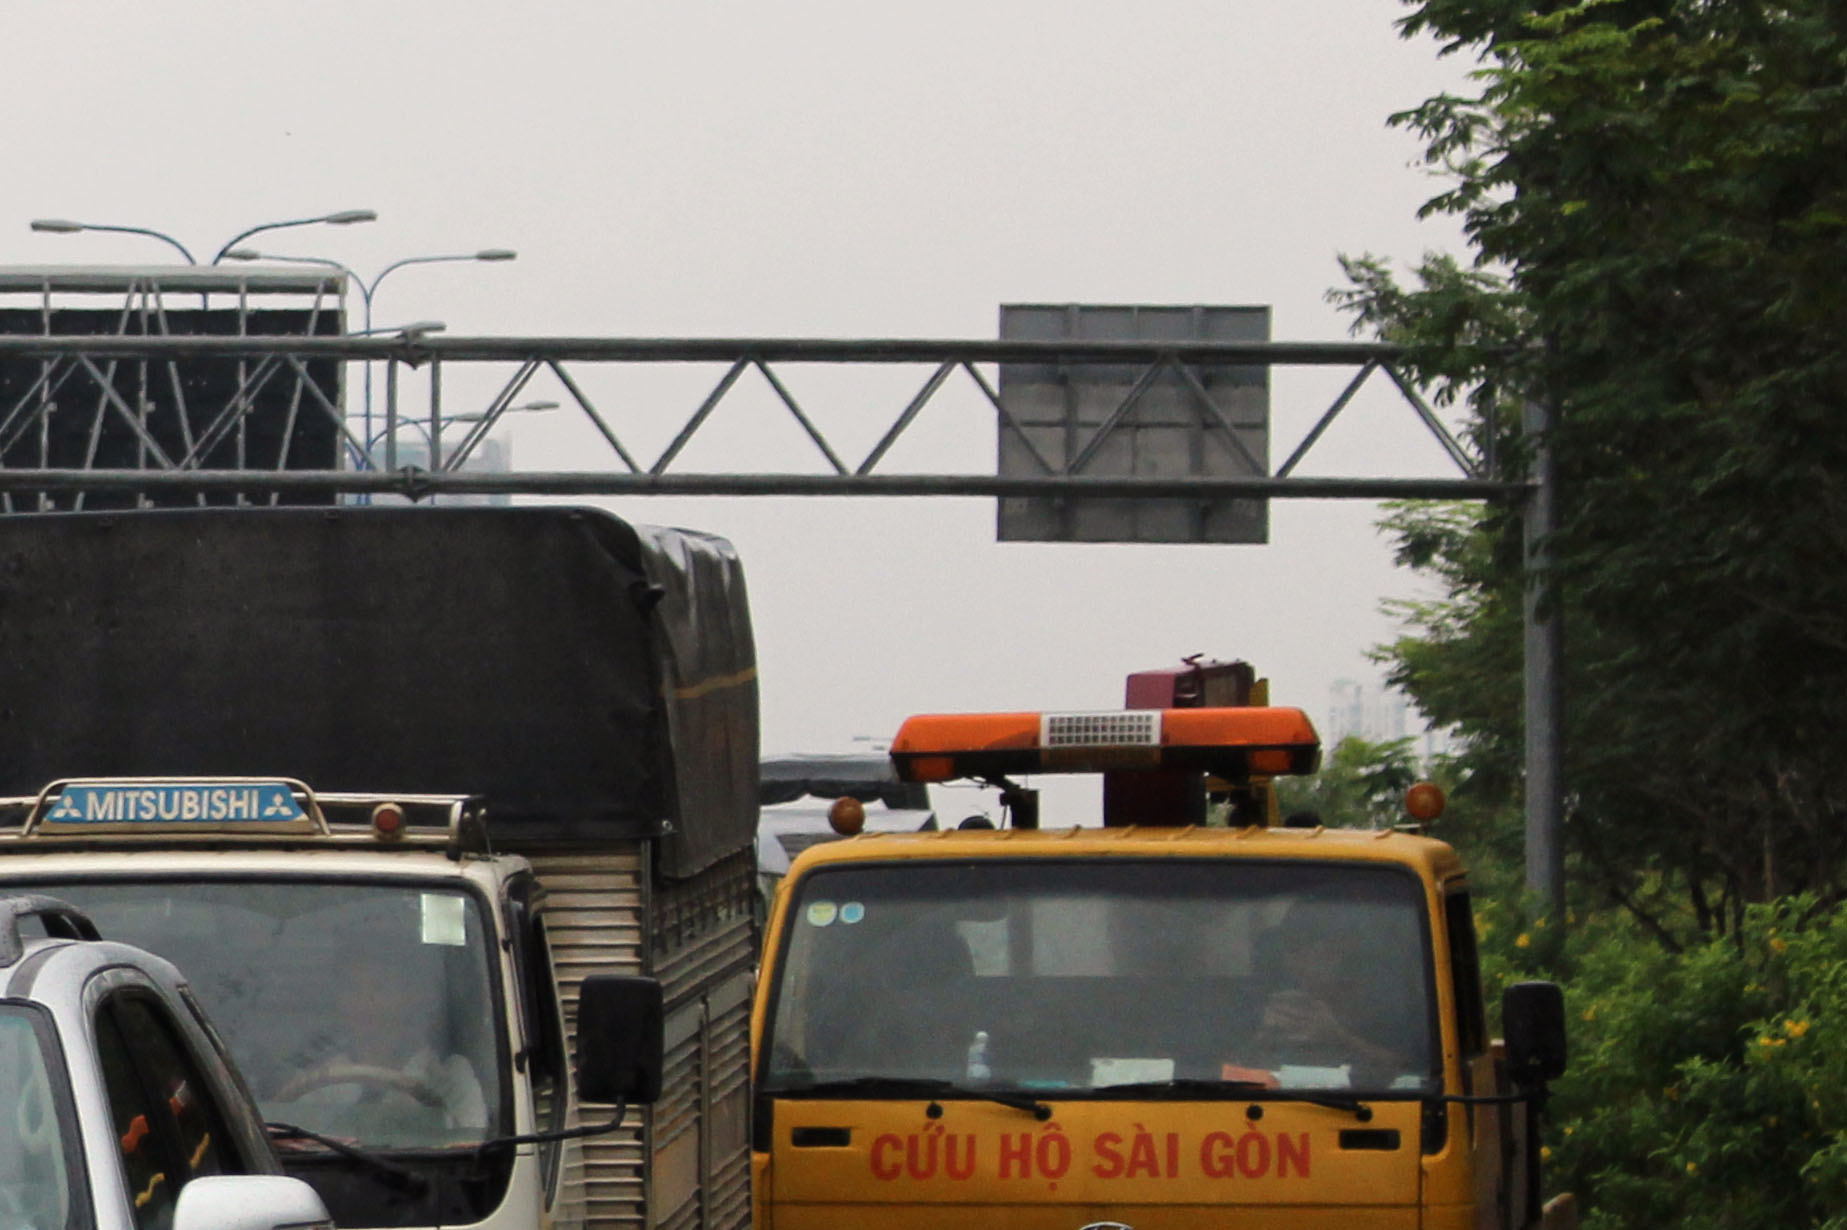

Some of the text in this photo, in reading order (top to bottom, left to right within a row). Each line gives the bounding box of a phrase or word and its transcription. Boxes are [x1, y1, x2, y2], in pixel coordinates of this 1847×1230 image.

[85, 789, 259, 821] MITSUBISHI
[870, 1120, 1310, 1191] CỨU HỘ SÀI GÒN
